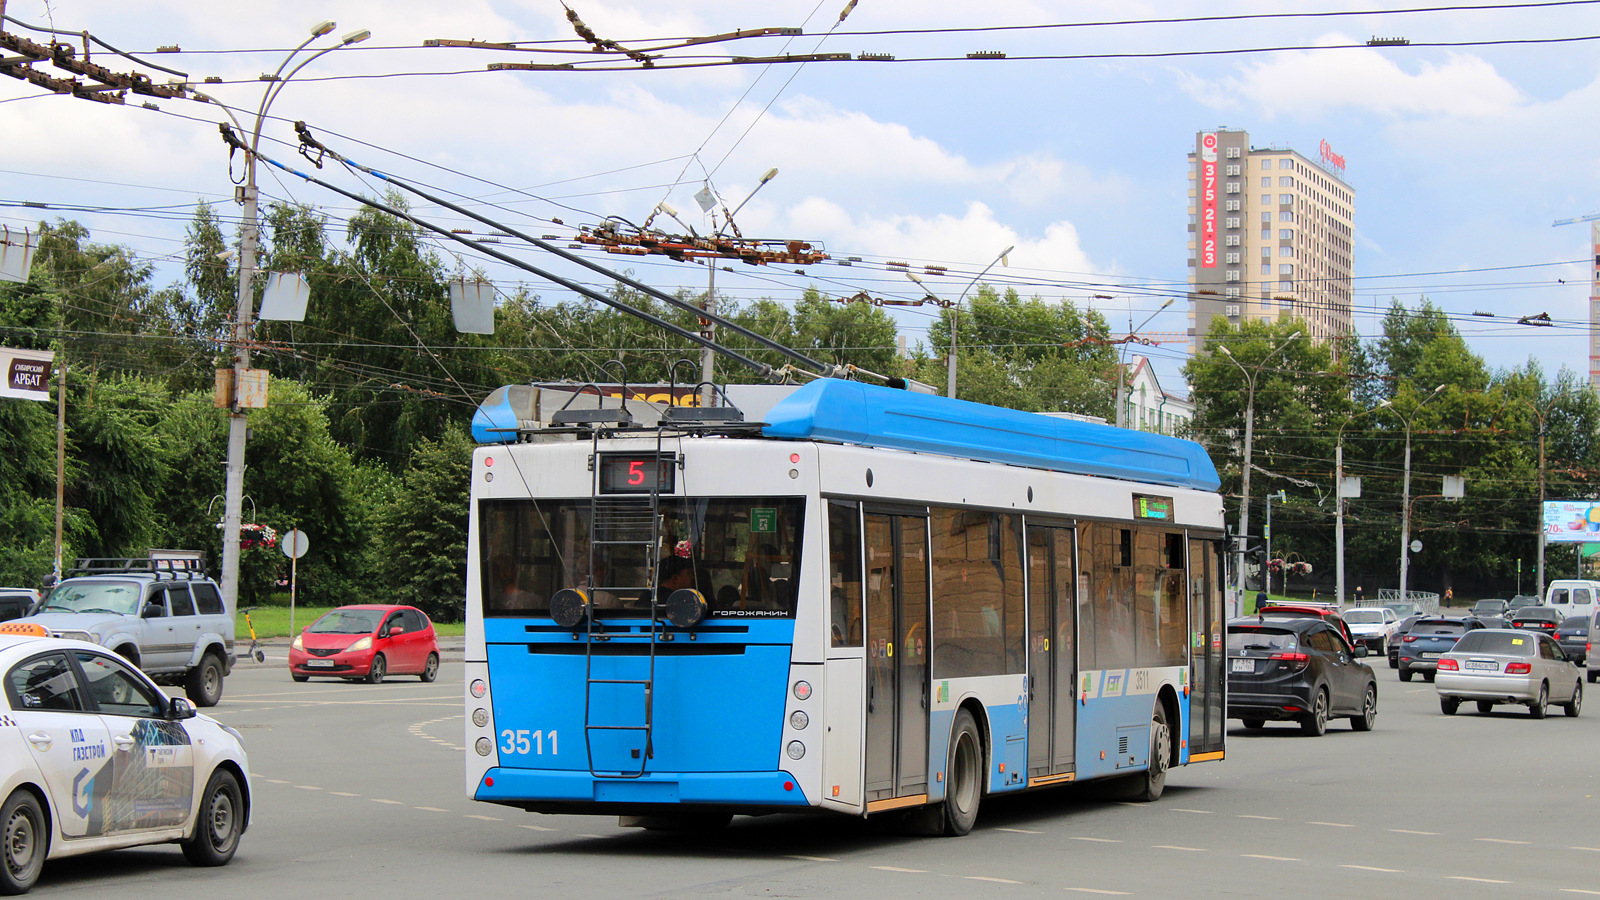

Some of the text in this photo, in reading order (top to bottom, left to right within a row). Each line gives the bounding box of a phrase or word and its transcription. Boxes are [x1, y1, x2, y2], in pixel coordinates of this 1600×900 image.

[14, 372, 42, 386] АРБАТ
[628, 461, 644, 485] 5
[1136, 670, 1148, 690] 3511
[70, 728, 84, 742] КПД
[501, 729, 558, 754] 3511
[73, 739, 105, 761] ГАЗСТРОЙ
